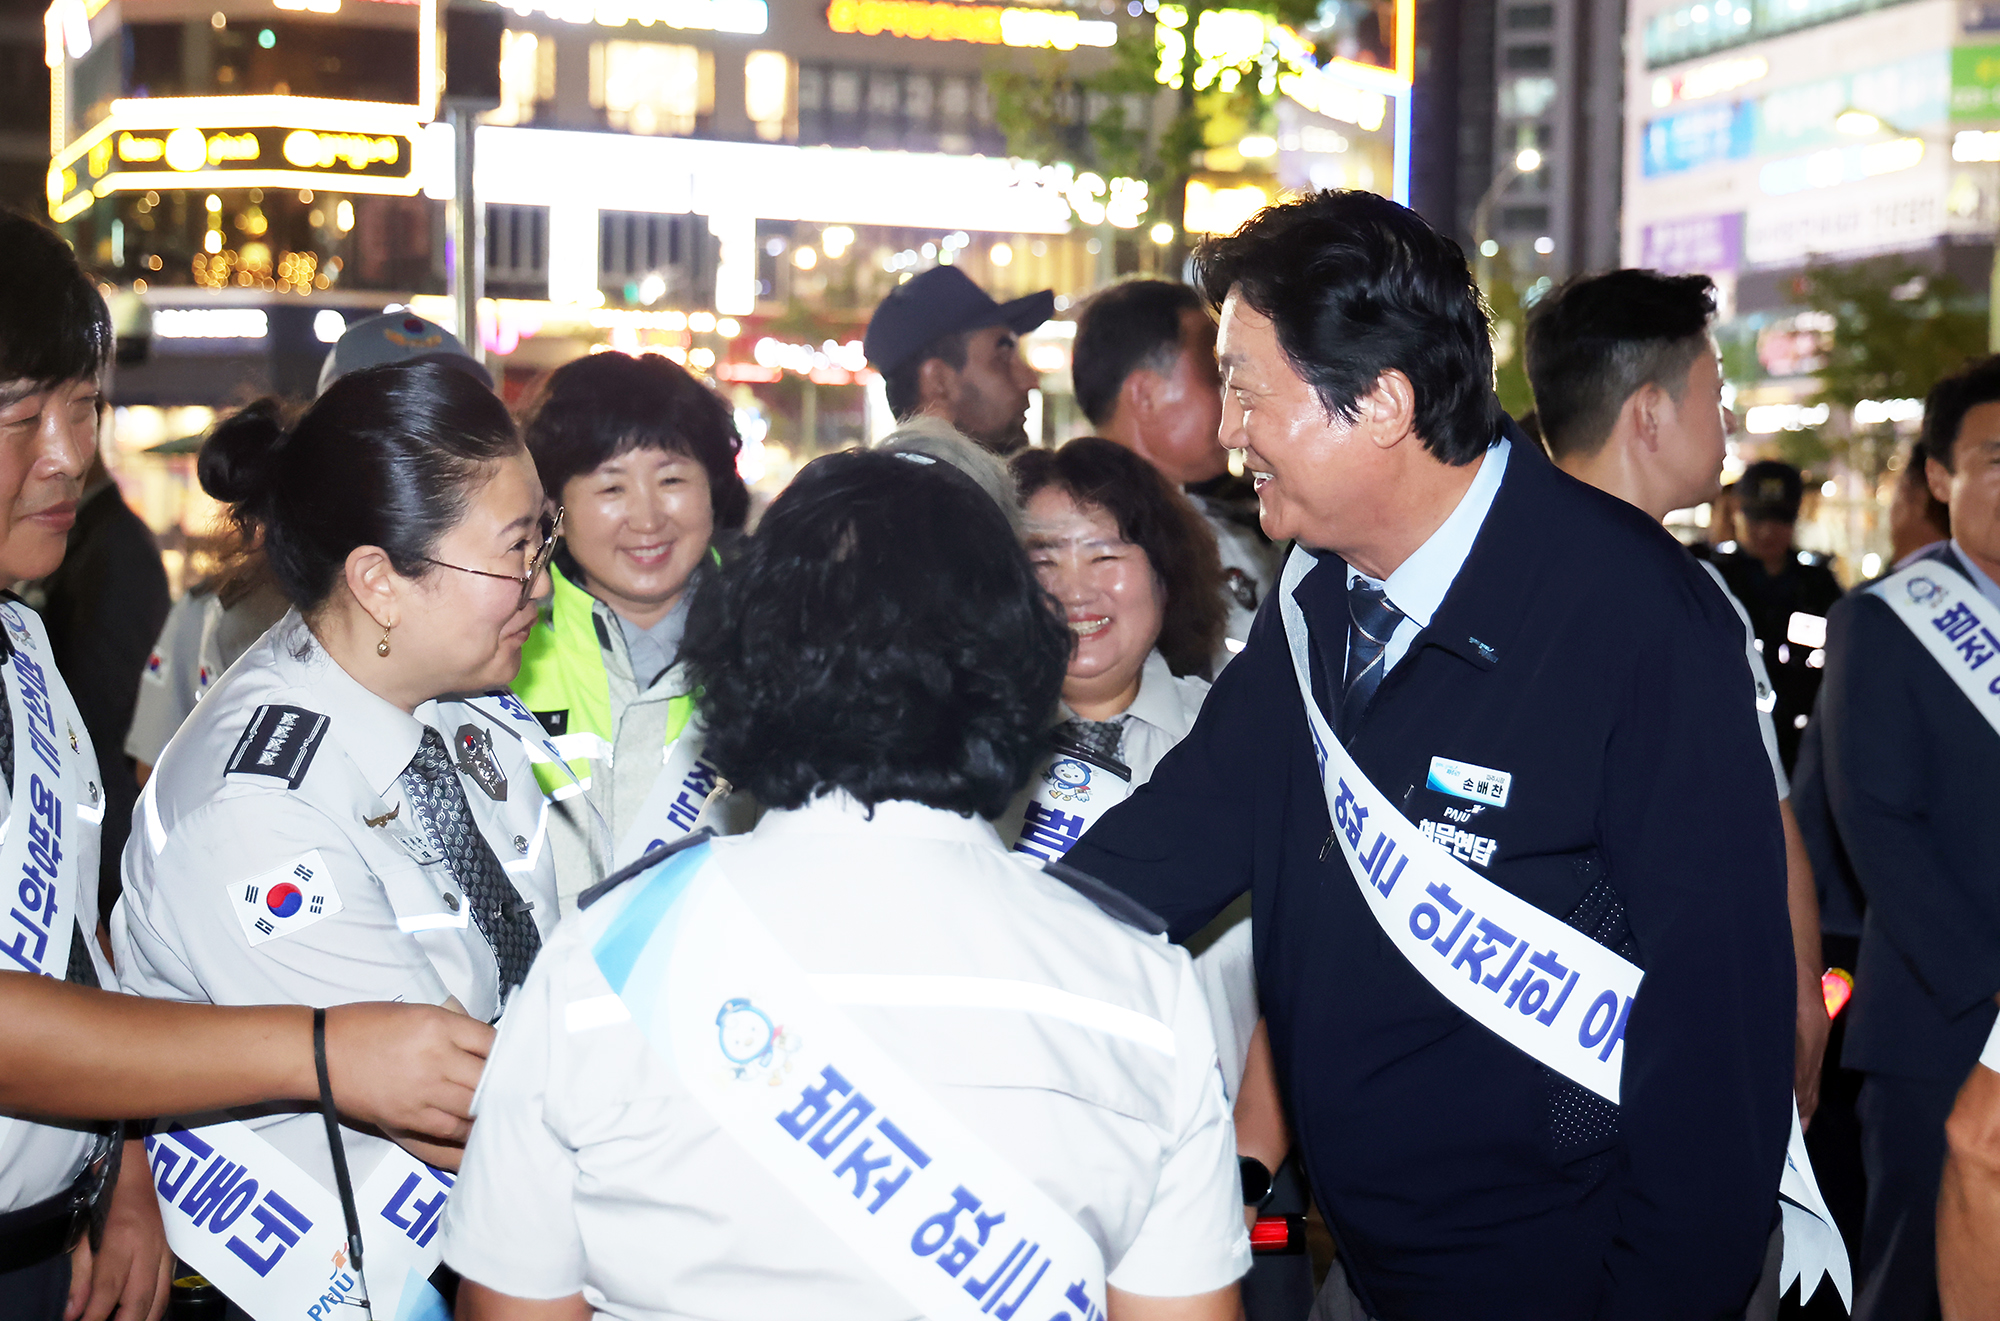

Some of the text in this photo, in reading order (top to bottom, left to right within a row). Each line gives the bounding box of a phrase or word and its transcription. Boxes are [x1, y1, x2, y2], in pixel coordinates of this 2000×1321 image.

[1012, 800, 1085, 863] 범
[1443, 806, 1471, 823] PAJU
[1334, 776, 1409, 899] 없는
[1409, 881, 1581, 1028] 안전한
[144, 1122, 314, 1278] 리동네
[775, 1063, 1052, 1321] 범죄 없는
[307, 1272, 354, 1321] PAJU
